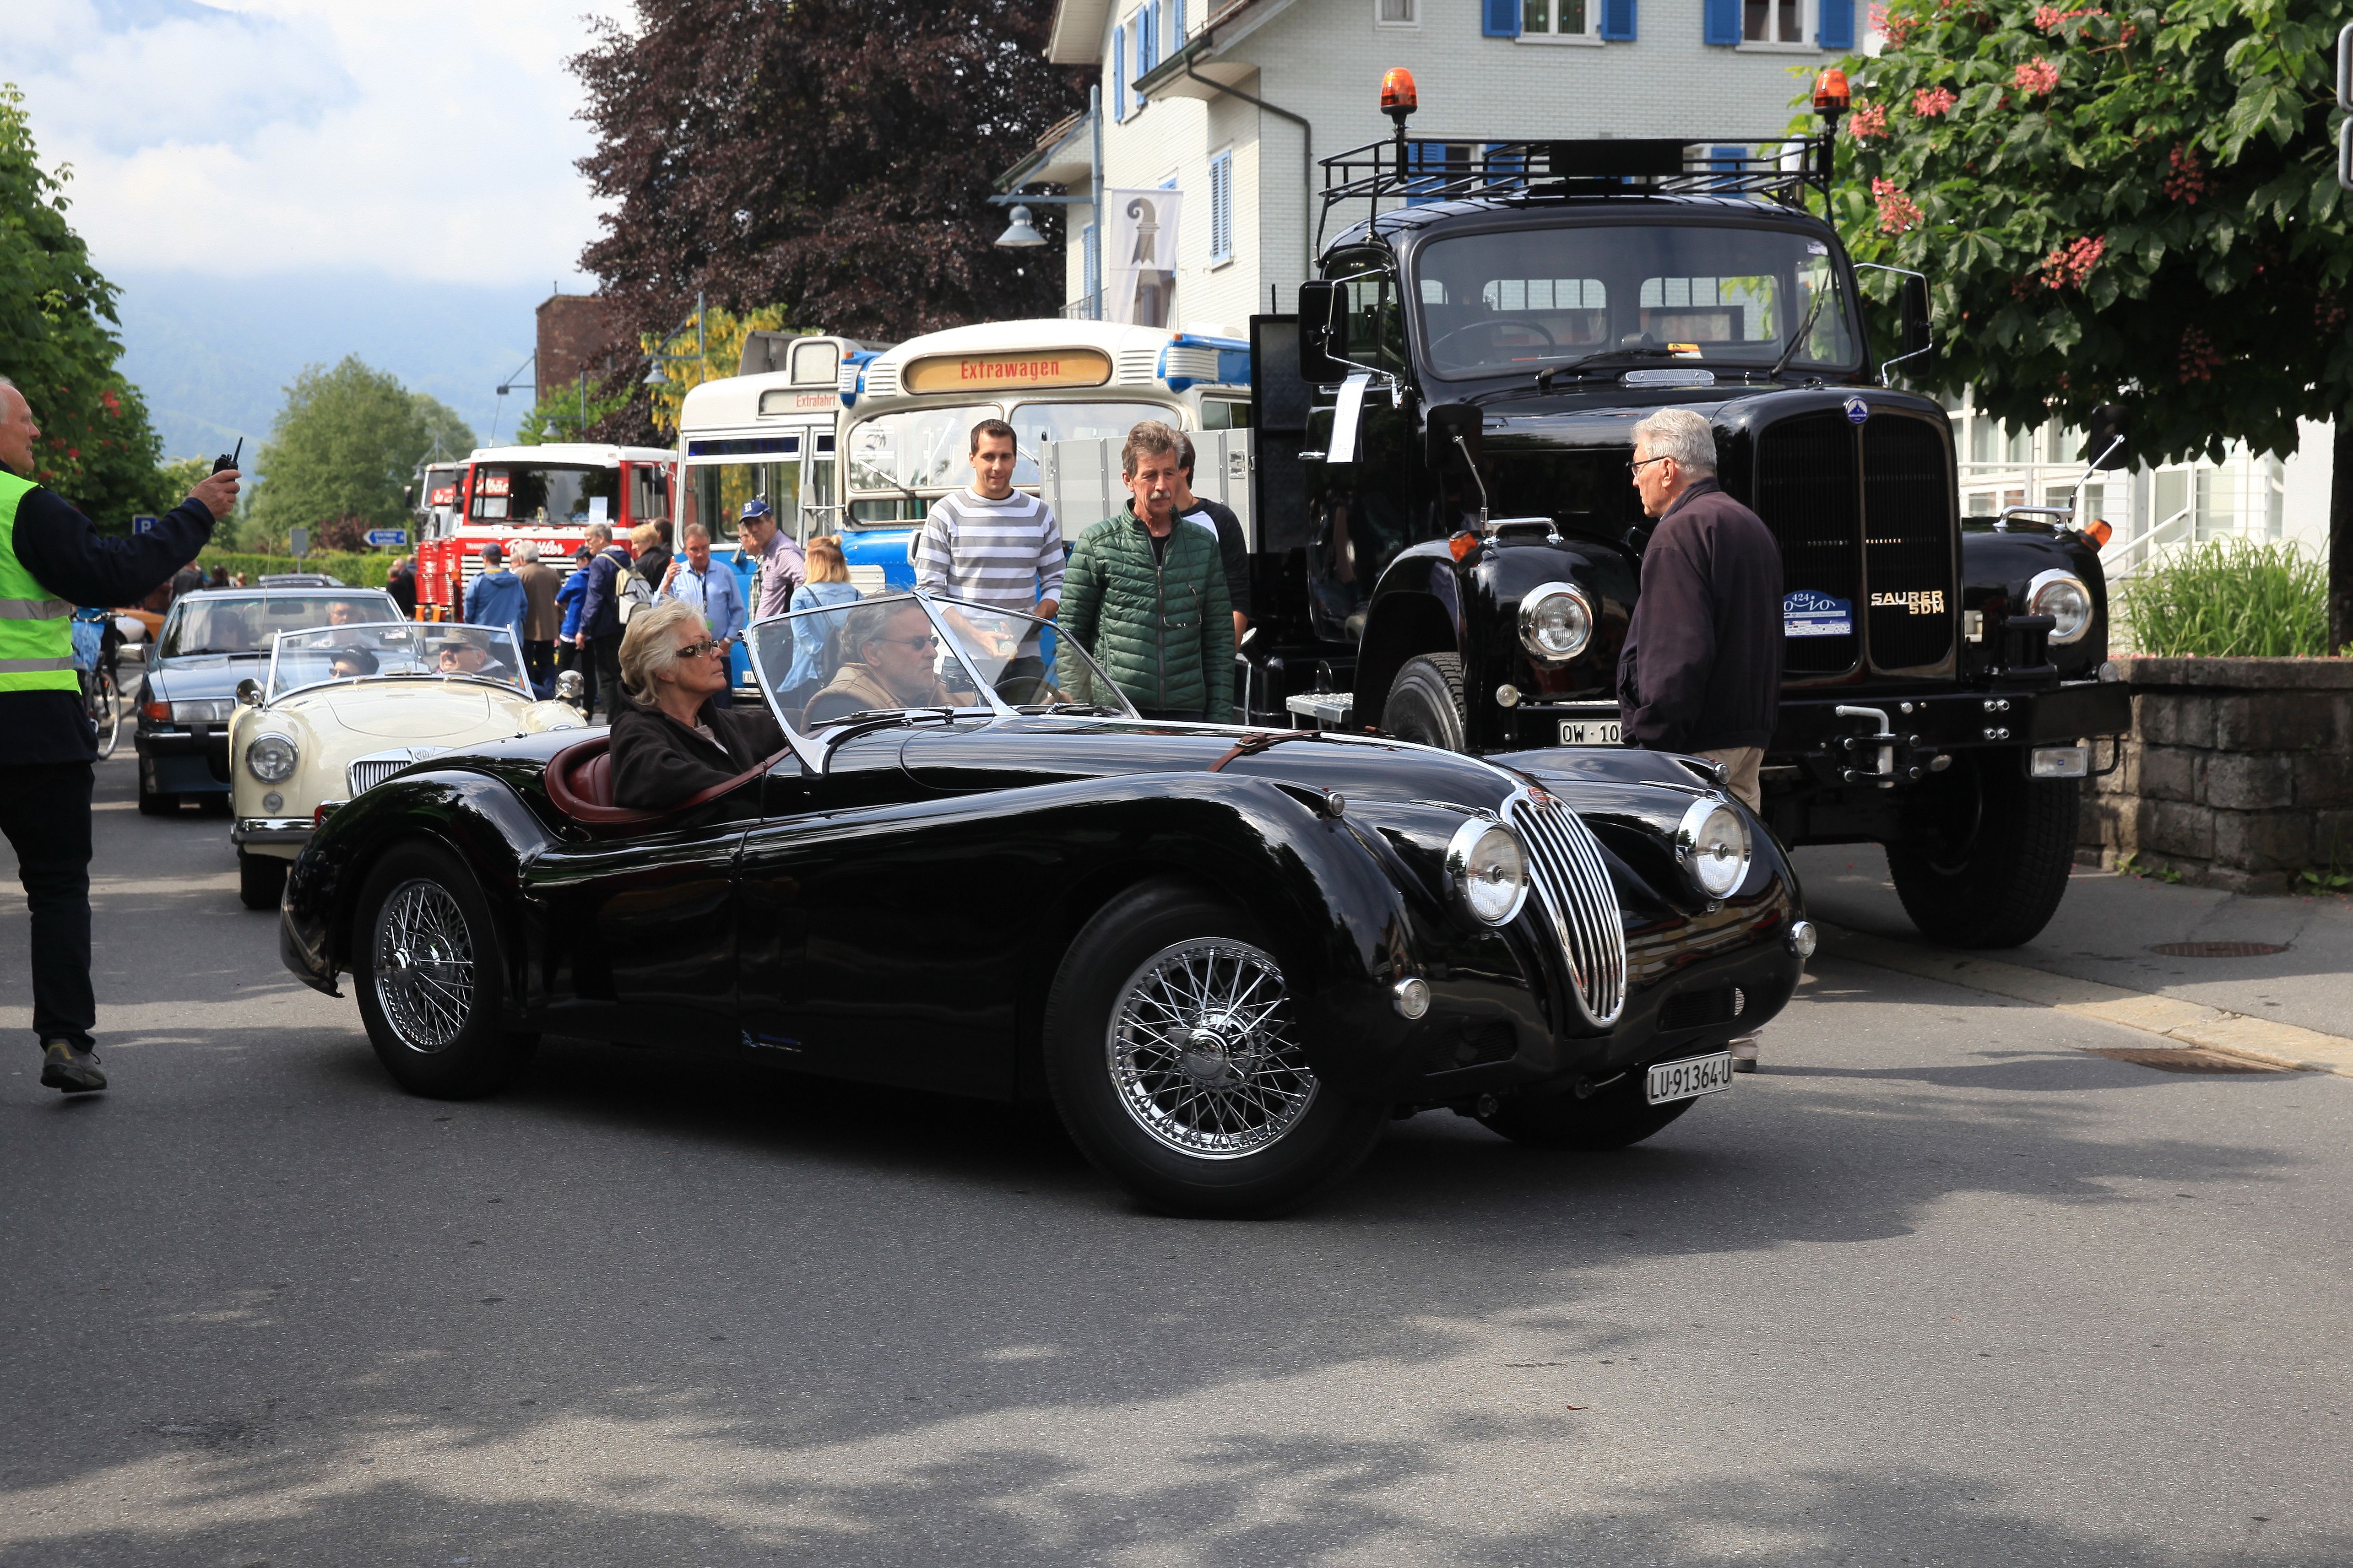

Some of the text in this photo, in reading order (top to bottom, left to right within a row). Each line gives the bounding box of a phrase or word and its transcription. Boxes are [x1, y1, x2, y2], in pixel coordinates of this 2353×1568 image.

[961, 360, 1060, 381] Extrawagen
[797, 395, 836, 407] Extrafahrt
[141, 520, 152, 534] P
[1792, 593, 1810, 602] 424
[1871, 590, 1944, 605] SAURER
[1909, 602, 1945, 615] 5DM
